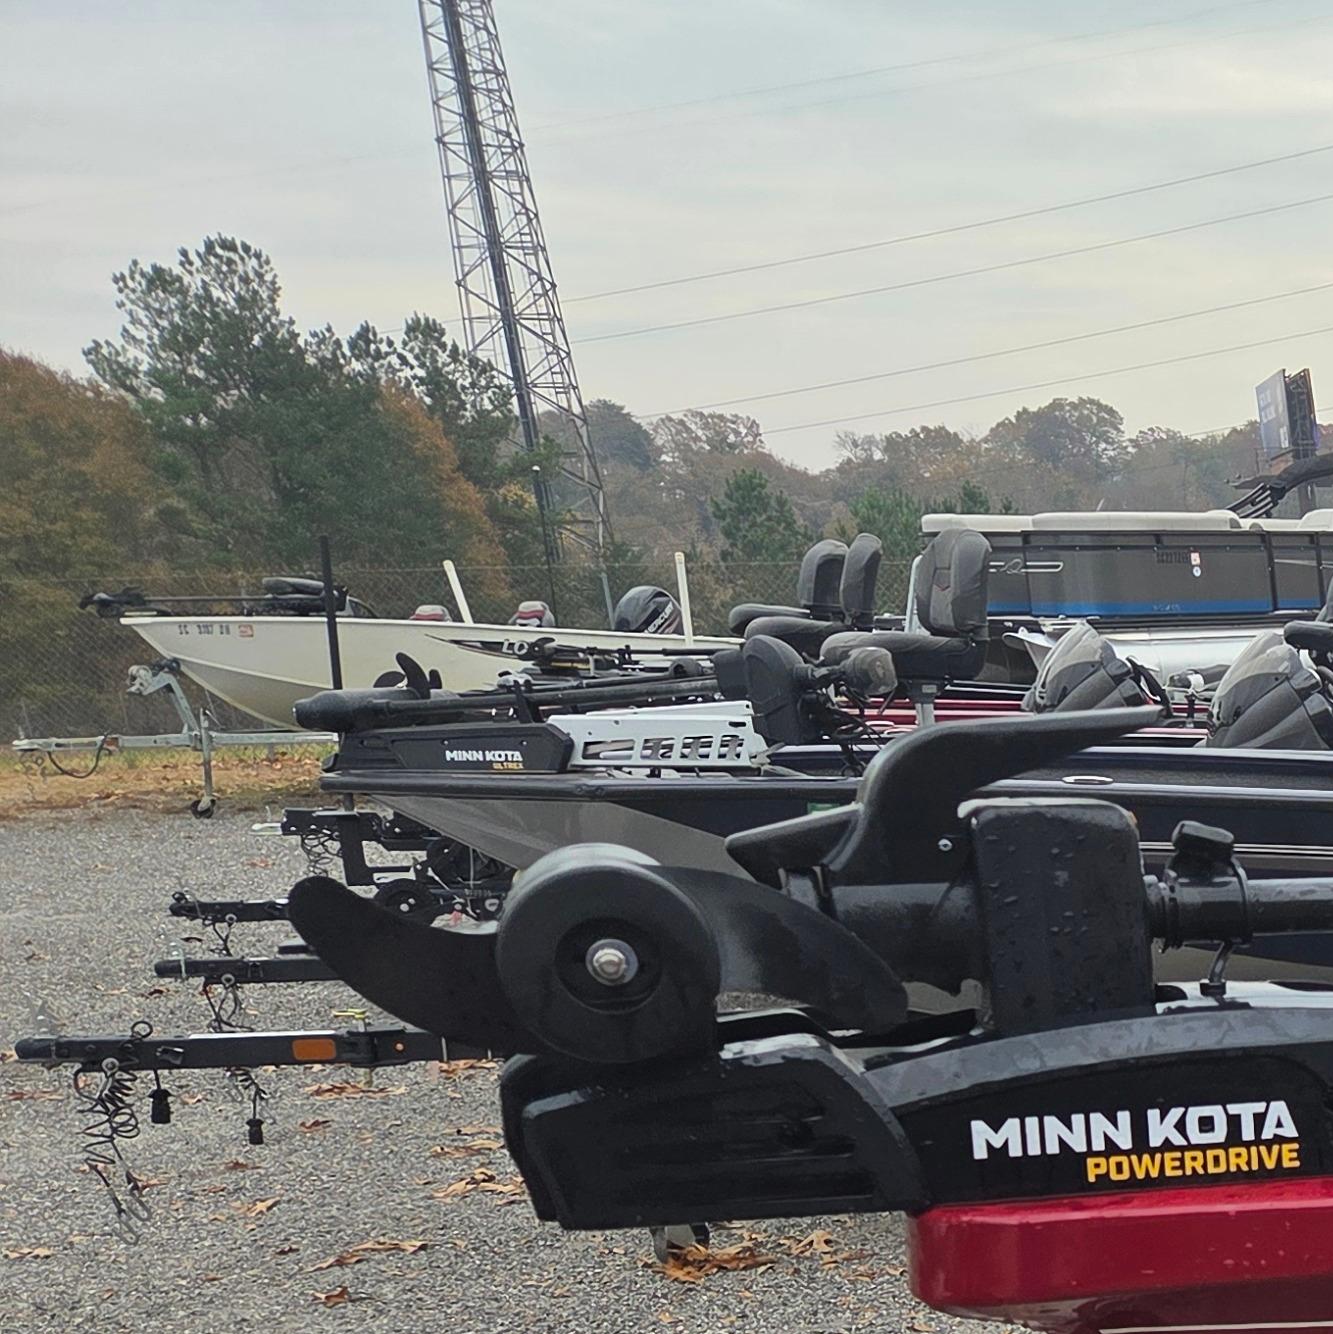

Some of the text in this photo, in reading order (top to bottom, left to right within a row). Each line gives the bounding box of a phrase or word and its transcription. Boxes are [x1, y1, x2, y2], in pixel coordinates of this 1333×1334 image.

[502, 639, 529, 655] LO
[445, 750, 523, 761] MINN KOTA
[970, 1100, 1299, 1160] MINN KOTA
[1086, 1142, 1301, 1183] POWERDRIVE
